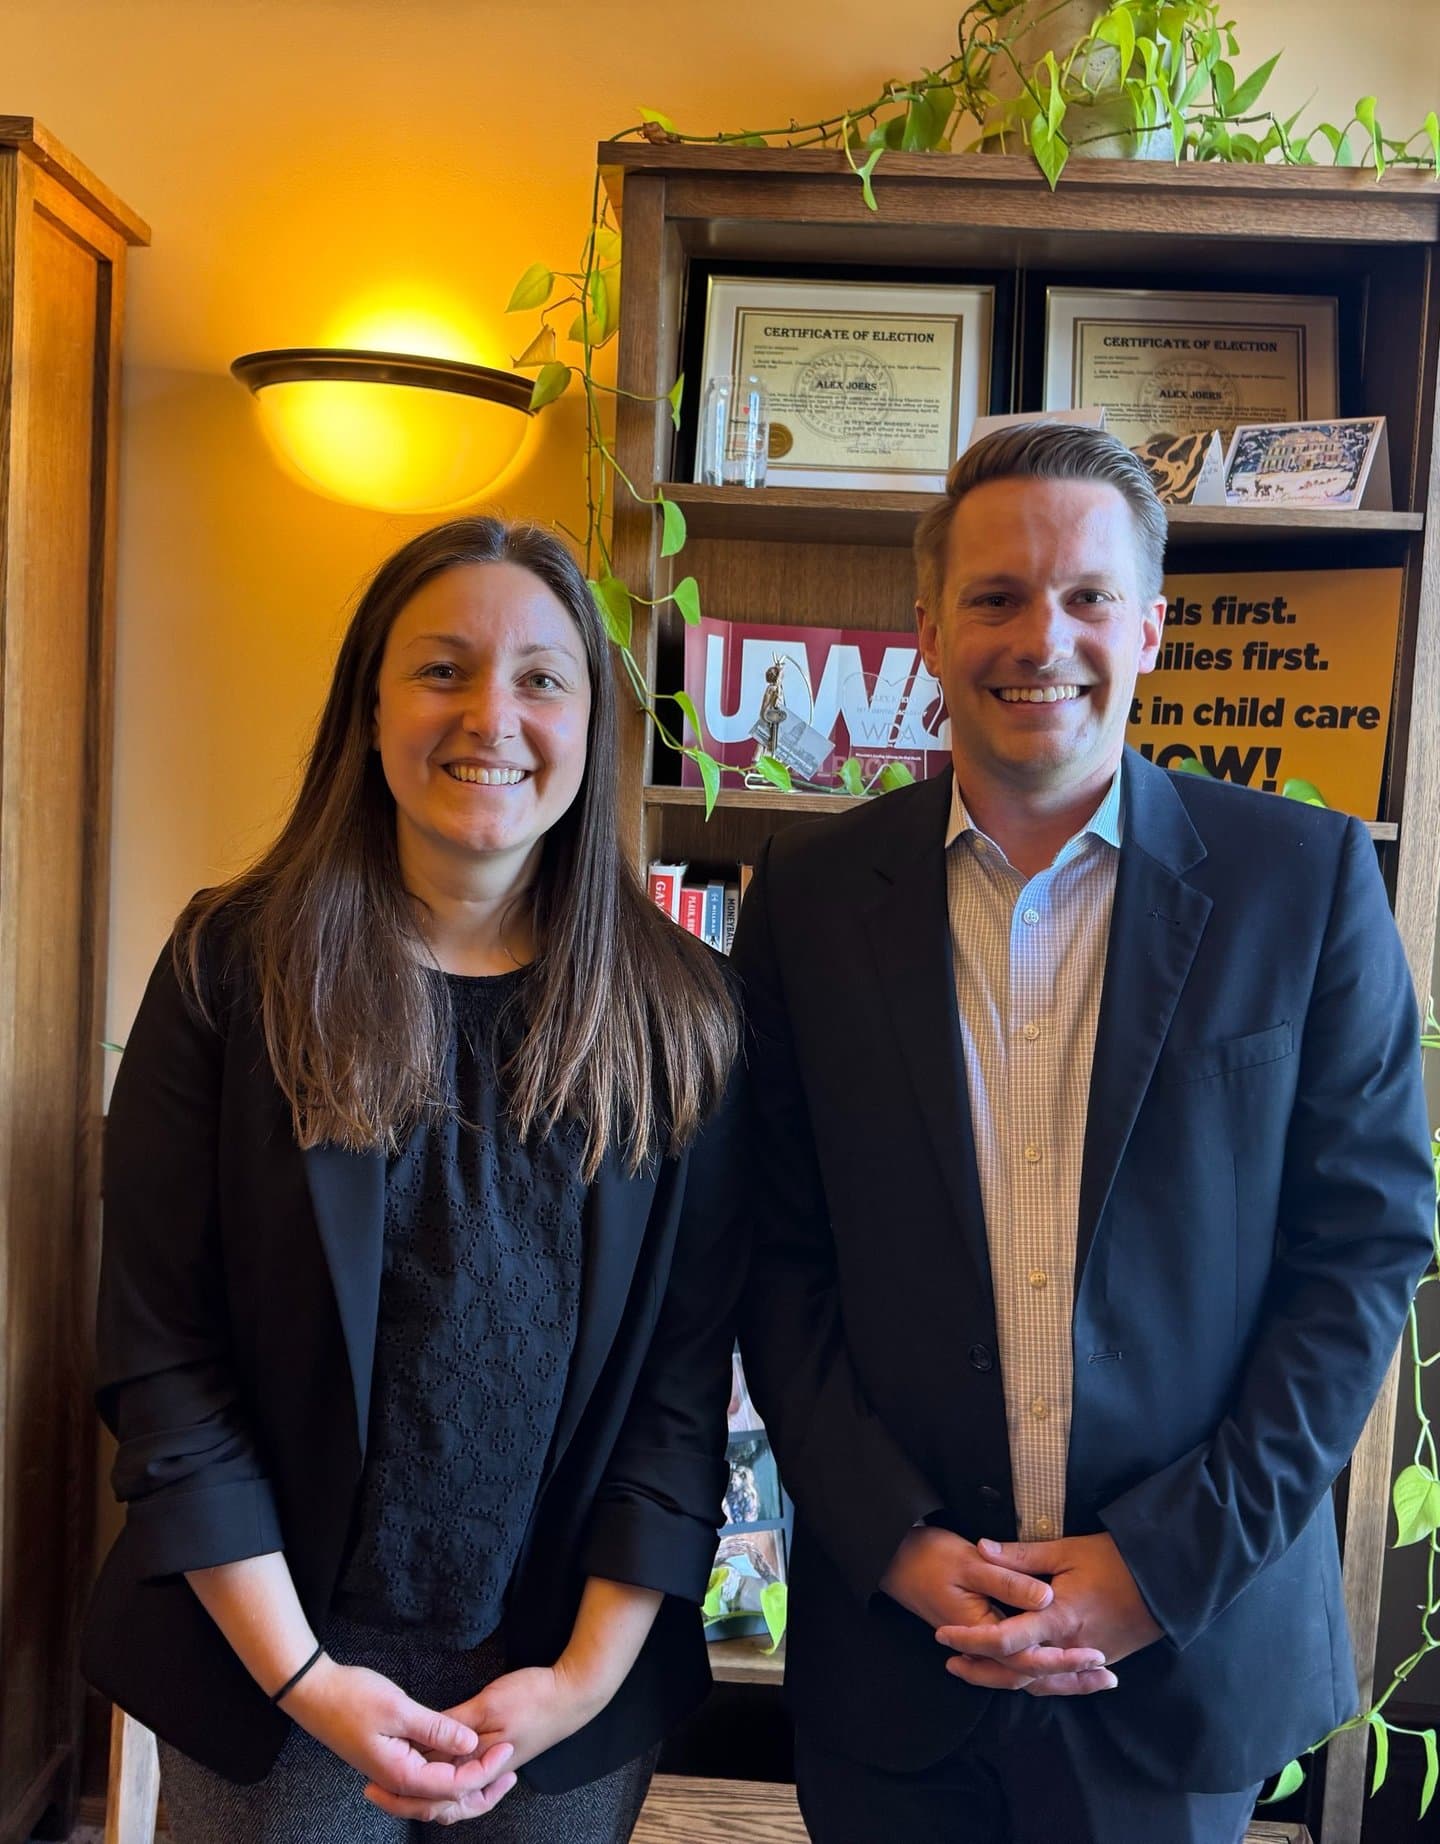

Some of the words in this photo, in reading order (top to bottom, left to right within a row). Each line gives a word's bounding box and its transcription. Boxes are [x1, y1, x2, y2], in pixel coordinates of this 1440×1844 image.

[764, 327, 849, 341] CERTIFICATE
[853, 330, 869, 341] OF
[872, 331, 935, 343] ELECTION
[1103, 336, 1191, 350] CERTIFICATE
[1194, 339, 1210, 350] OF
[1213, 339, 1278, 353] ELECTION
[816, 381, 844, 390] ALEX
[846, 382, 878, 392] JOERS
[1158, 388, 1187, 399] ALEX
[1189, 389, 1223, 400] JOERS
[1165, 597, 1202, 626] ds
[1212, 596, 1297, 626] first.
[1154, 642, 1233, 671] ilies
[1242, 641, 1328, 671] first.
[1151, 696, 1184, 726] in
[1193, 697, 1286, 728] child
[1294, 704, 1381, 730] care
[726, 898, 736, 948] MONEYBALL
